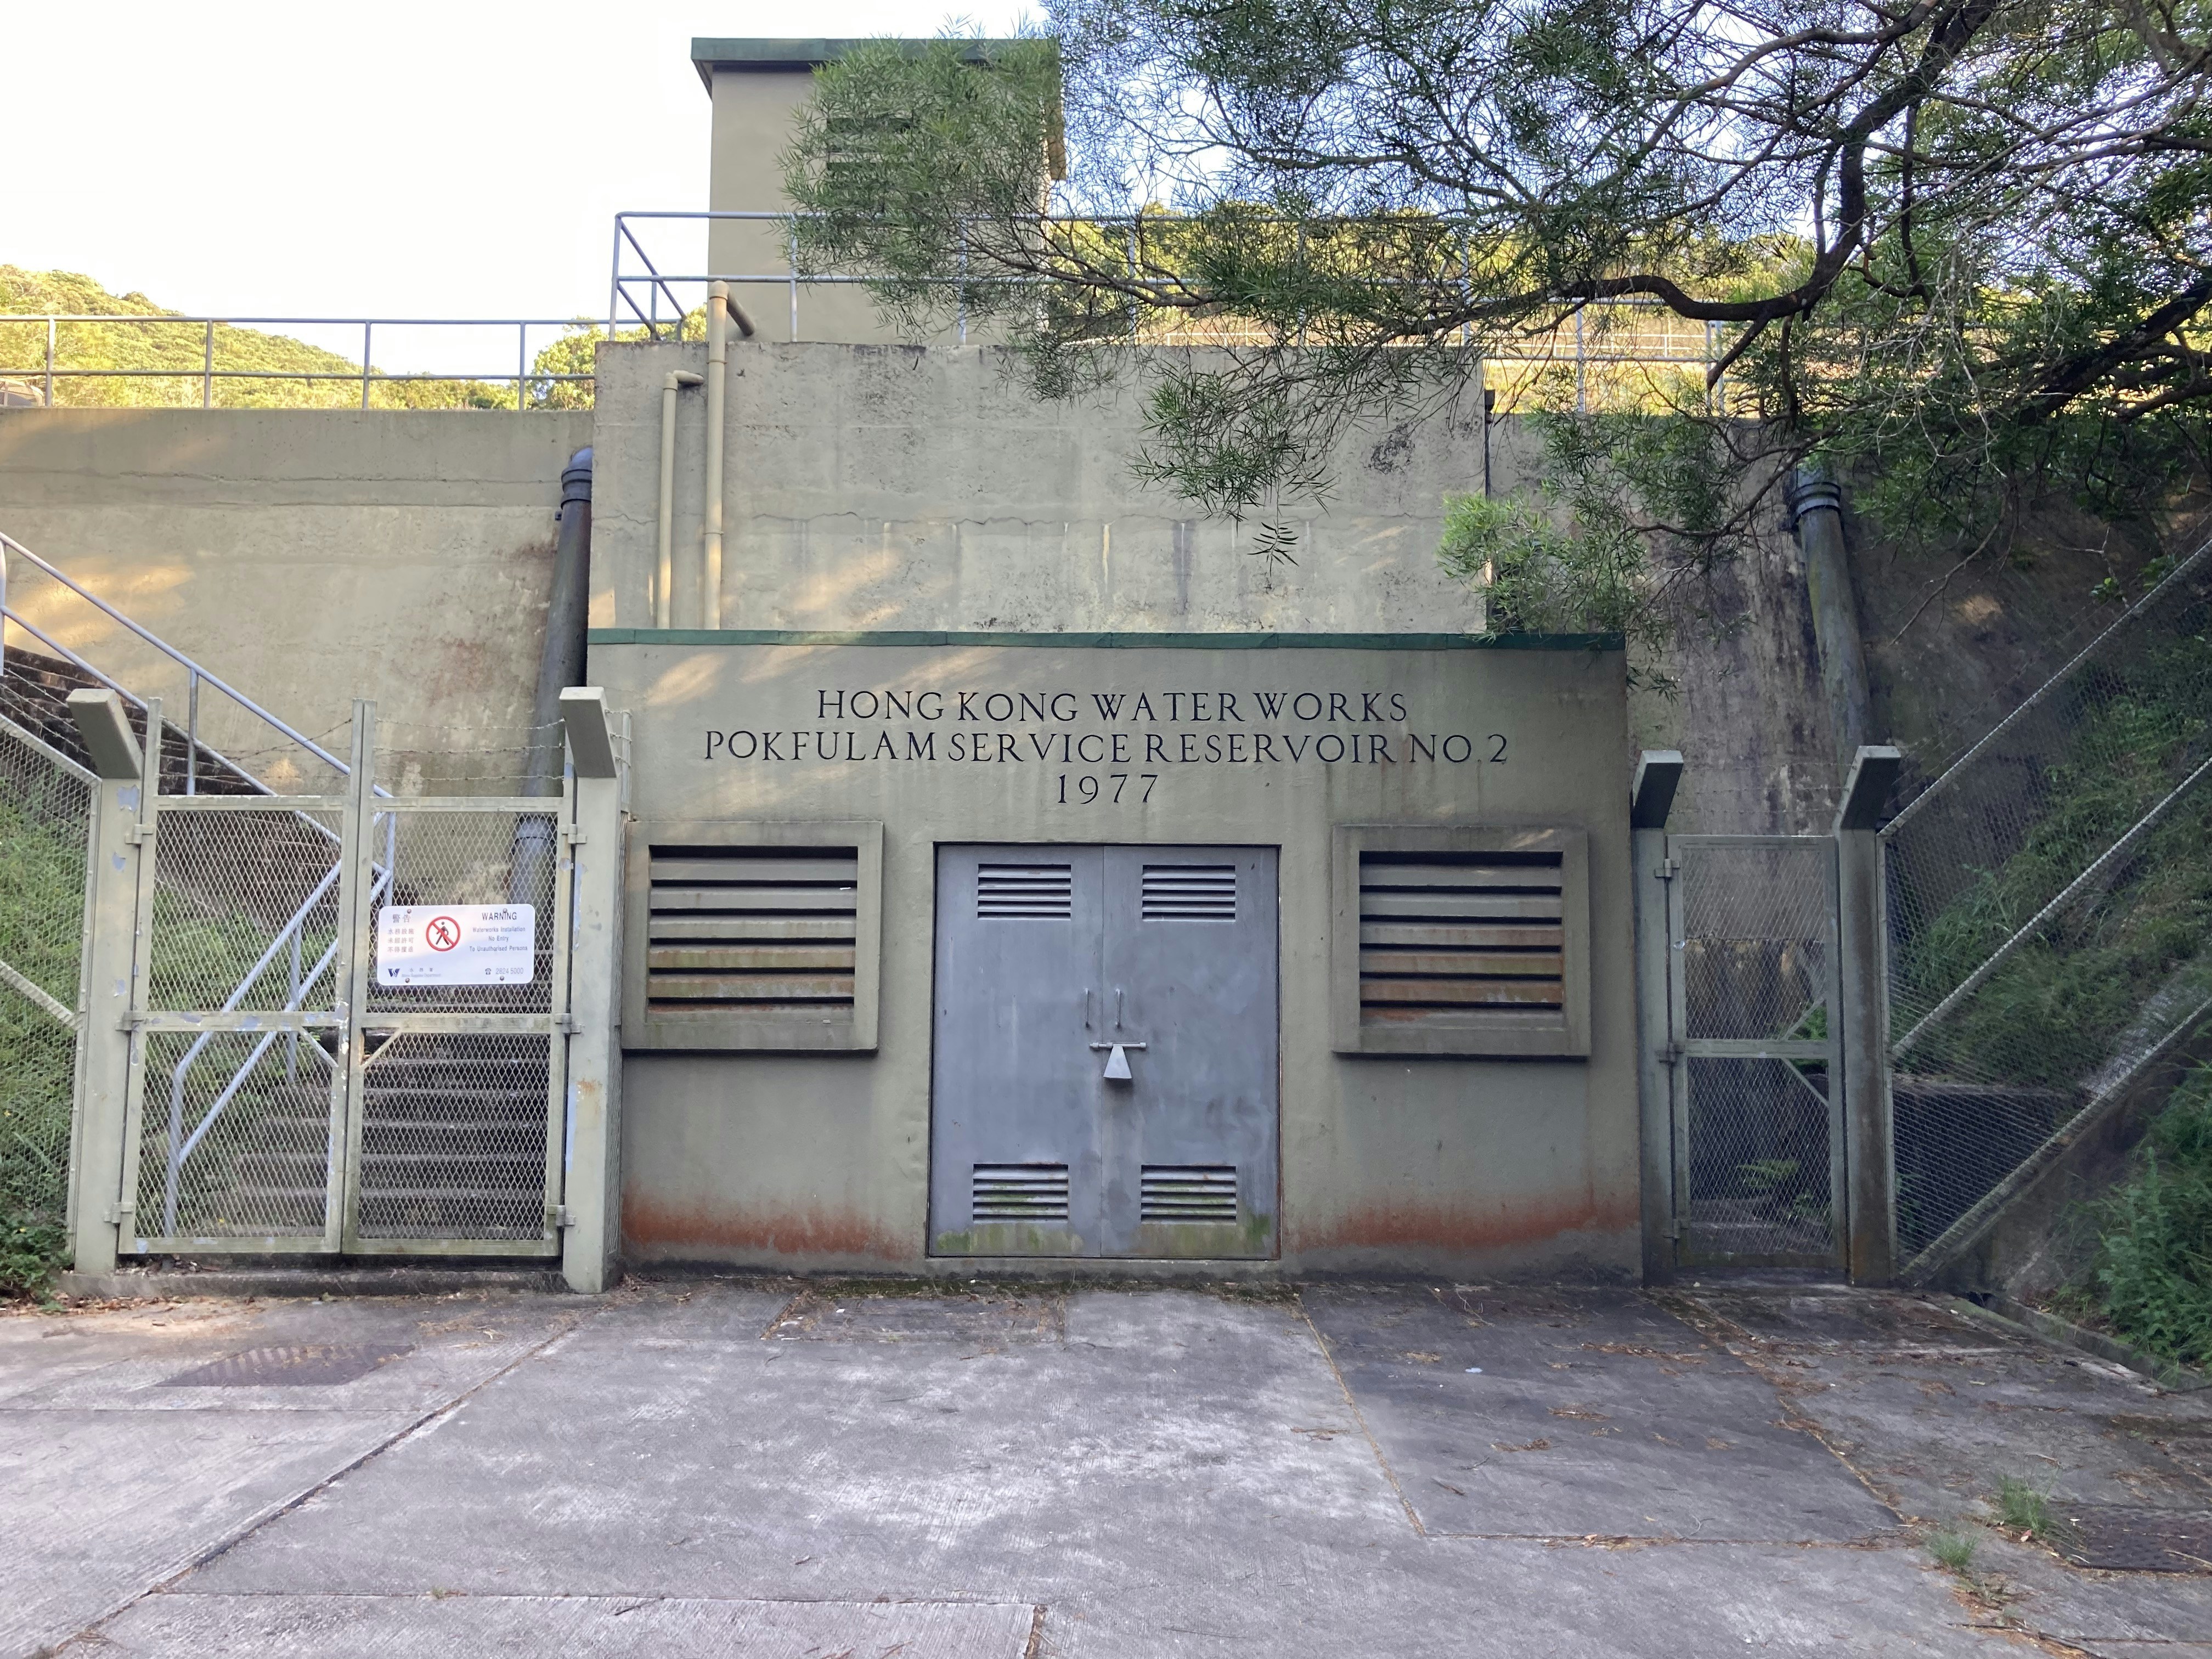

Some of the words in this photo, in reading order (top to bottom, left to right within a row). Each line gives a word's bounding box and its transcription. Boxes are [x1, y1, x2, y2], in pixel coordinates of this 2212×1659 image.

[817, 690, 945, 720] HONG
[957, 691, 1079, 723] KONG
[704, 730, 937, 761] POKFULAM
[947, 732, 1131, 763] SERVICE
[1144, 733, 1397, 764] RESERVOIR
[1487, 733, 1508, 763] 2
[1057, 774, 1158, 805] 1977
[393, 914, 411, 923] 警告
[482, 912, 517, 921] WARNING
